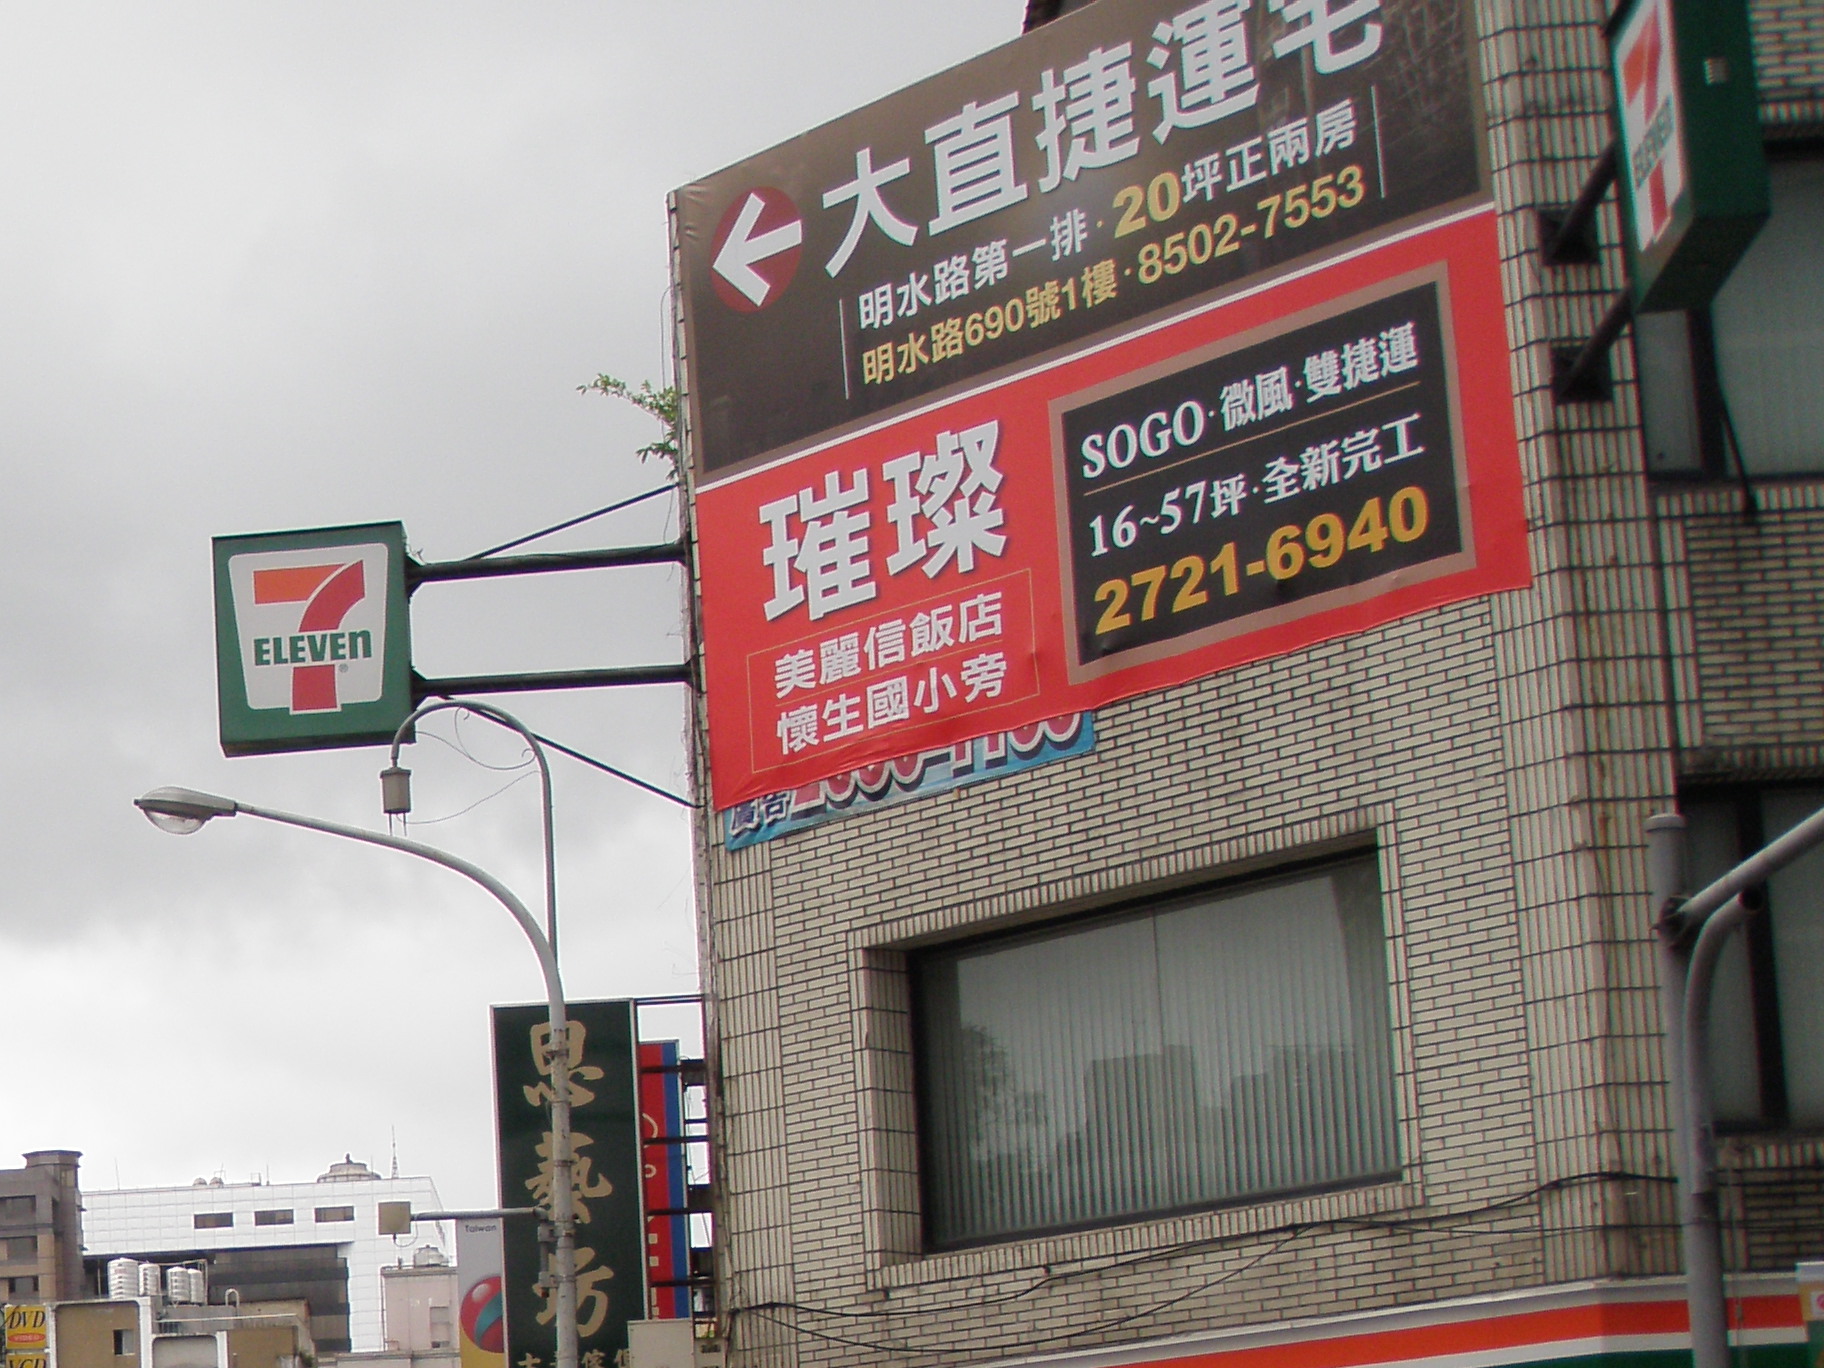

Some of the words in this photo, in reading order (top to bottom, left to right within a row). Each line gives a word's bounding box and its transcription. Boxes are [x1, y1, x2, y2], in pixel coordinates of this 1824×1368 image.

[1095, 484, 1431, 635] 2721-6940
[775, 591, 1004, 699] 美麗信飯店
[776, 654, 1007, 754] 懷生國小旁
[8, 1309, 46, 1330] DVD
